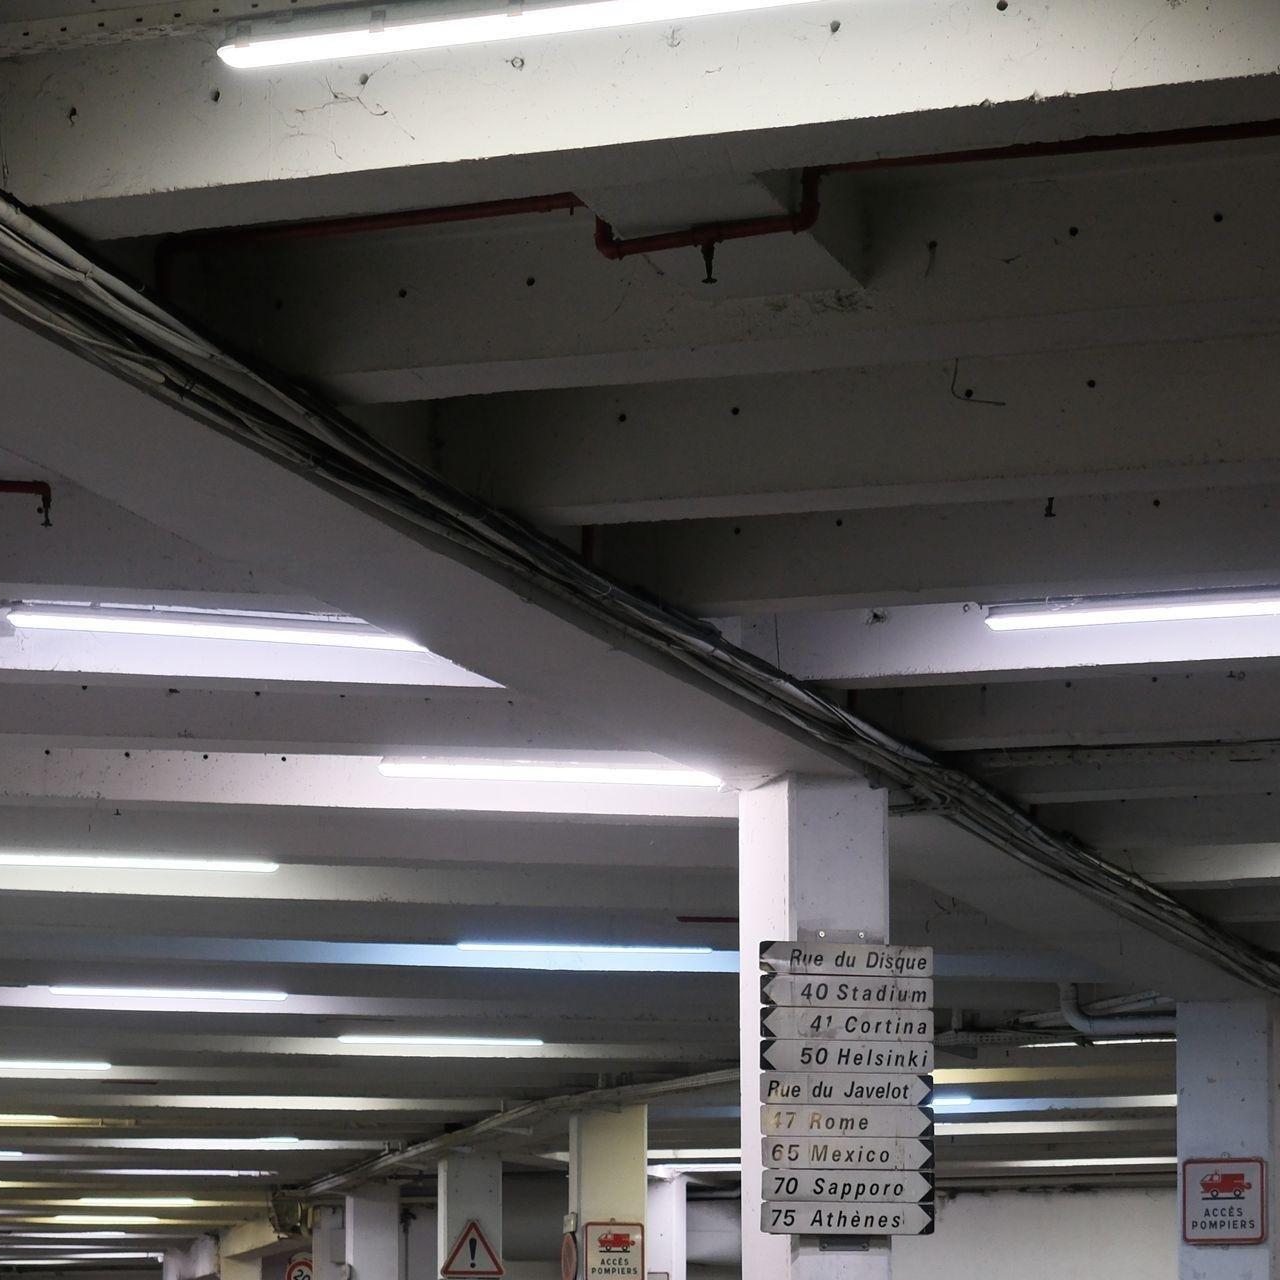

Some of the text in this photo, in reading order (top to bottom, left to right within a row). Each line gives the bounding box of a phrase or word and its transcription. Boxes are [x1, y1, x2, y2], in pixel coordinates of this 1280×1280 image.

[790, 949, 927, 973] Rue du Disque
[801, 983, 927, 1003] 40 Stadium
[811, 1015, 927, 1034] 41 Cortina
[800, 1047, 927, 1067] 50 Helsinki
[768, 1080, 909, 1099] Rue du Javelot
[810, 1112, 869, 1130] Rome
[771, 1144, 890, 1162] 65 Mexico
[774, 1177, 903, 1200] 70 Sapporo
[772, 1209, 900, 1228] 75 Athènes
[1192, 1220, 1255, 1230] POMPIERS
[591, 1267, 638, 1275] POMPIERS
